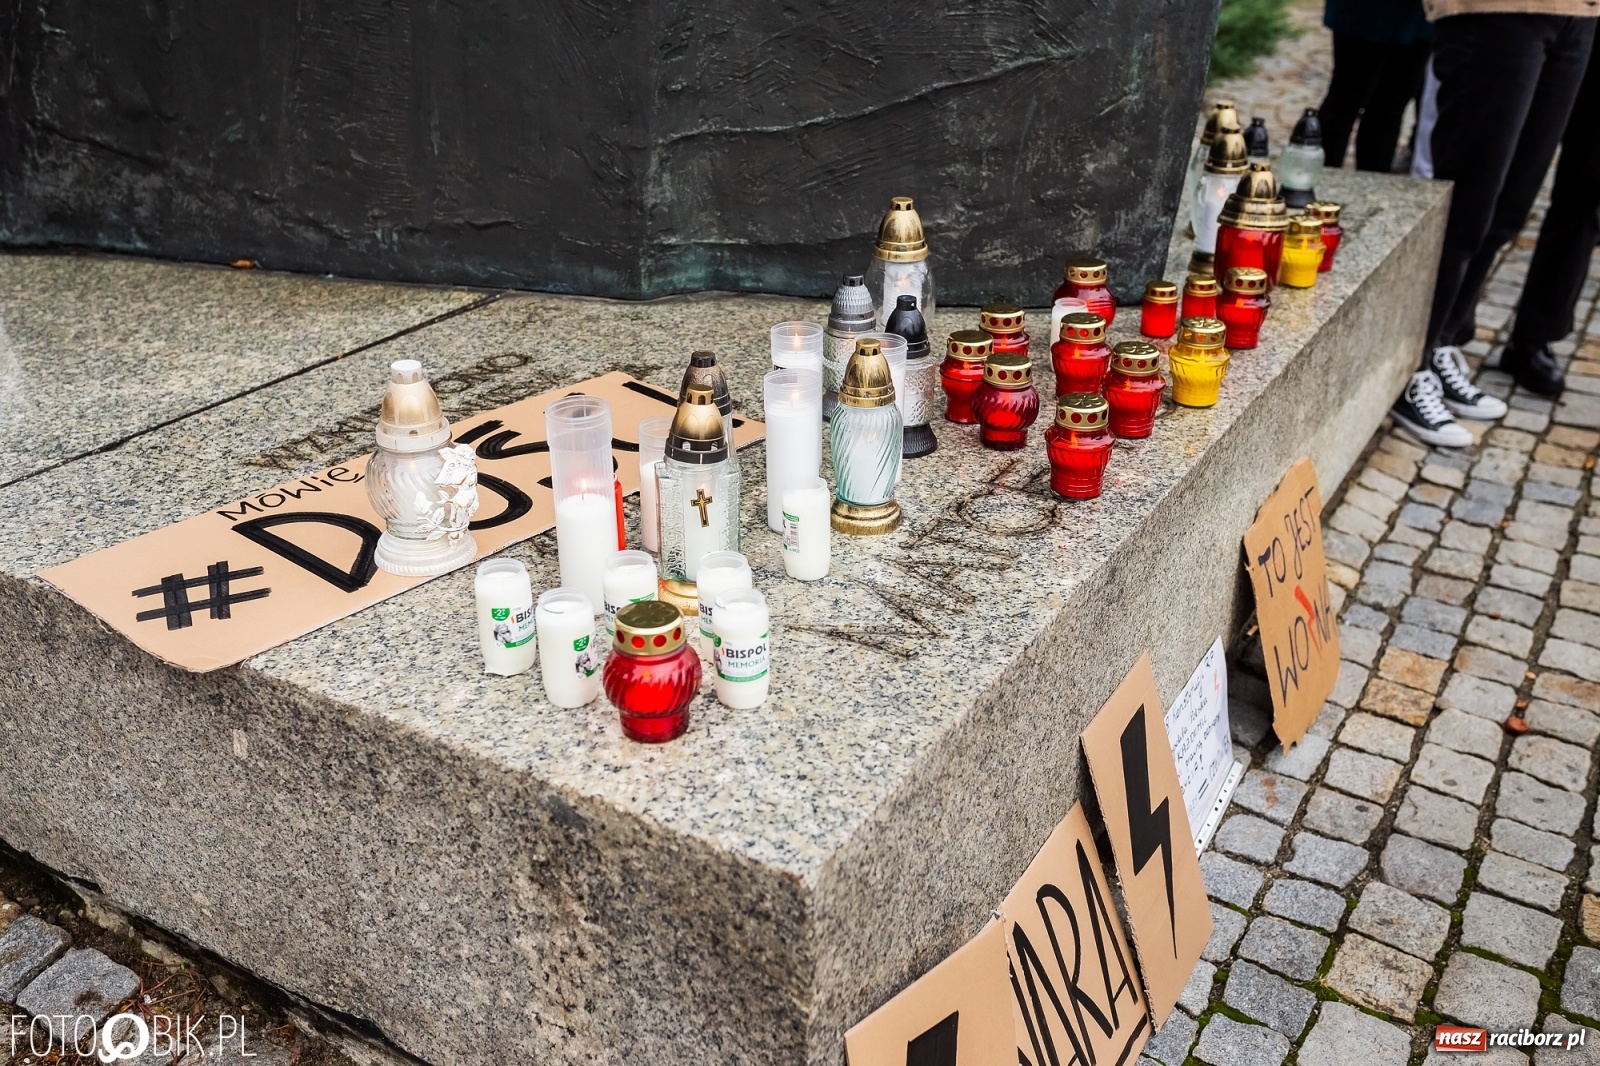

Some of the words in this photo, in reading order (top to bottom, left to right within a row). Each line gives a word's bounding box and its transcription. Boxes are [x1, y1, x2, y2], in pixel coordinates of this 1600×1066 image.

[1258, 536, 1287, 598] TO
[1284, 486, 1316, 580] JEST
[699, 603, 713, 617] BIS
[726, 643, 767, 659] BISPOL
[728, 656, 766, 669] MEMORIA
[1006, 838, 1139, 1066] ARA
